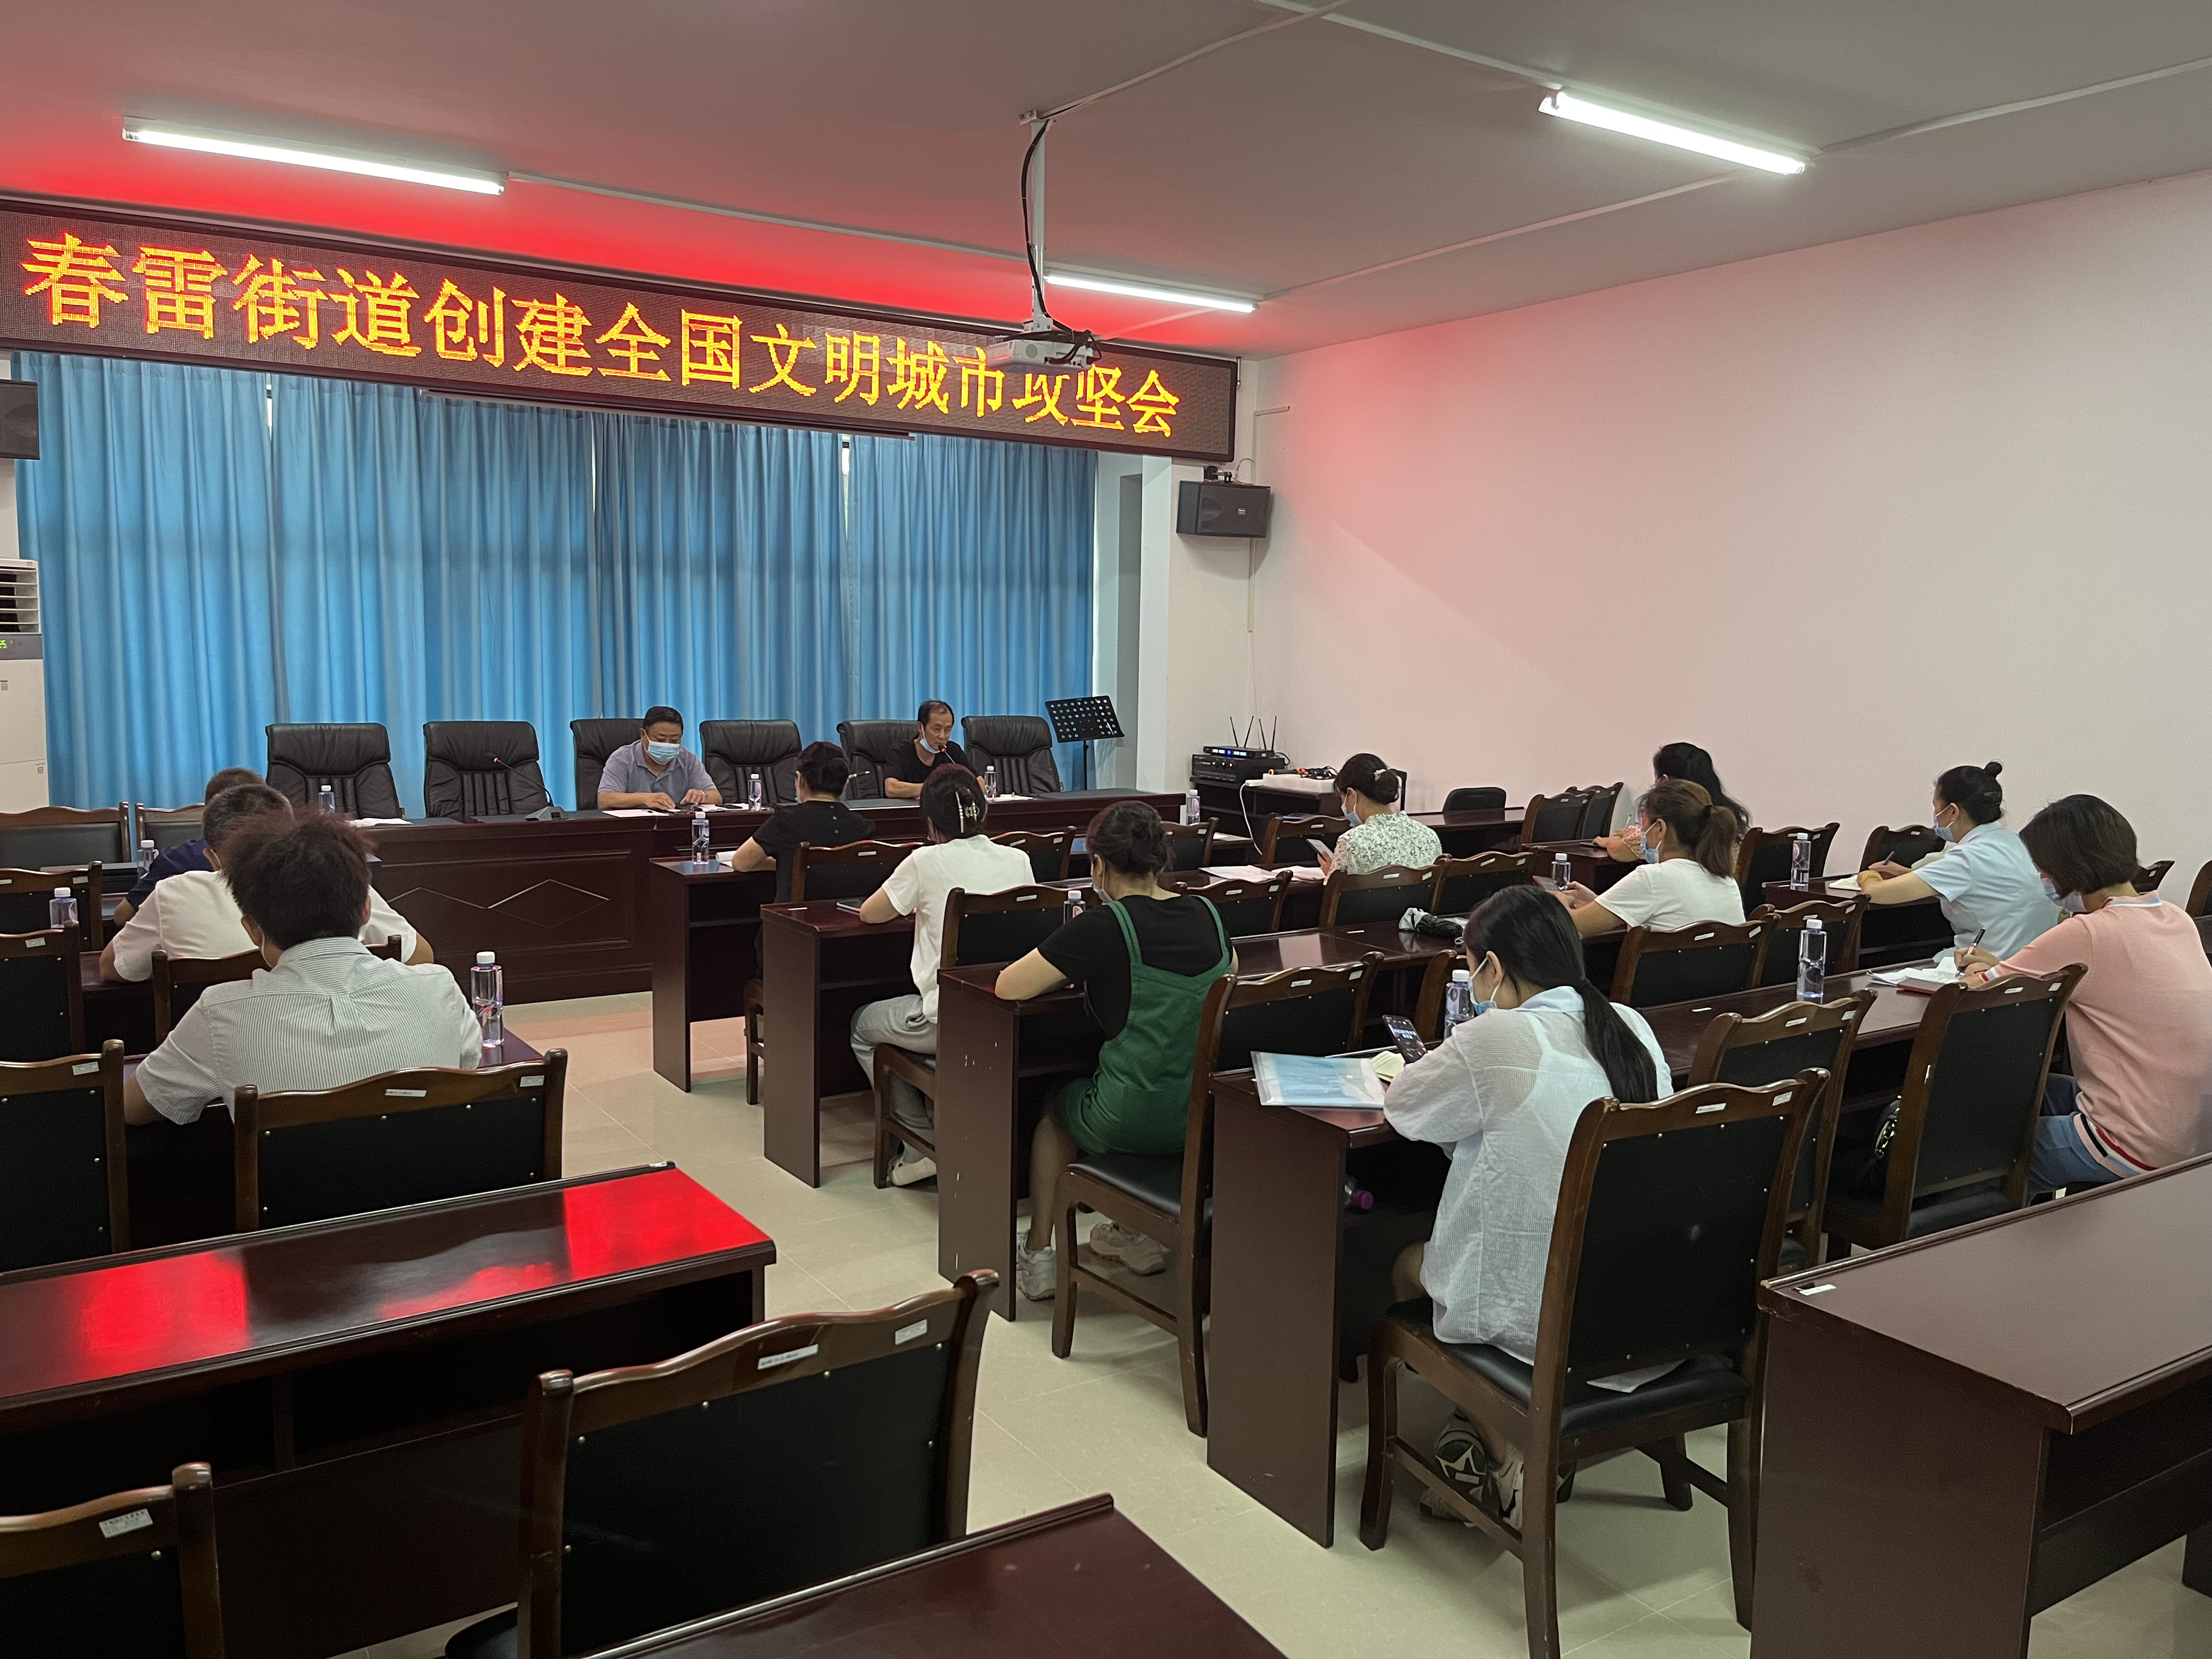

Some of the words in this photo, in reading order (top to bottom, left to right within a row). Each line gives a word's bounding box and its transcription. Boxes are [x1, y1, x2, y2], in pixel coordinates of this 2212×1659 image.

[21, 232, 1180, 437] 春雷街道创建全国文明城市攻坚会
